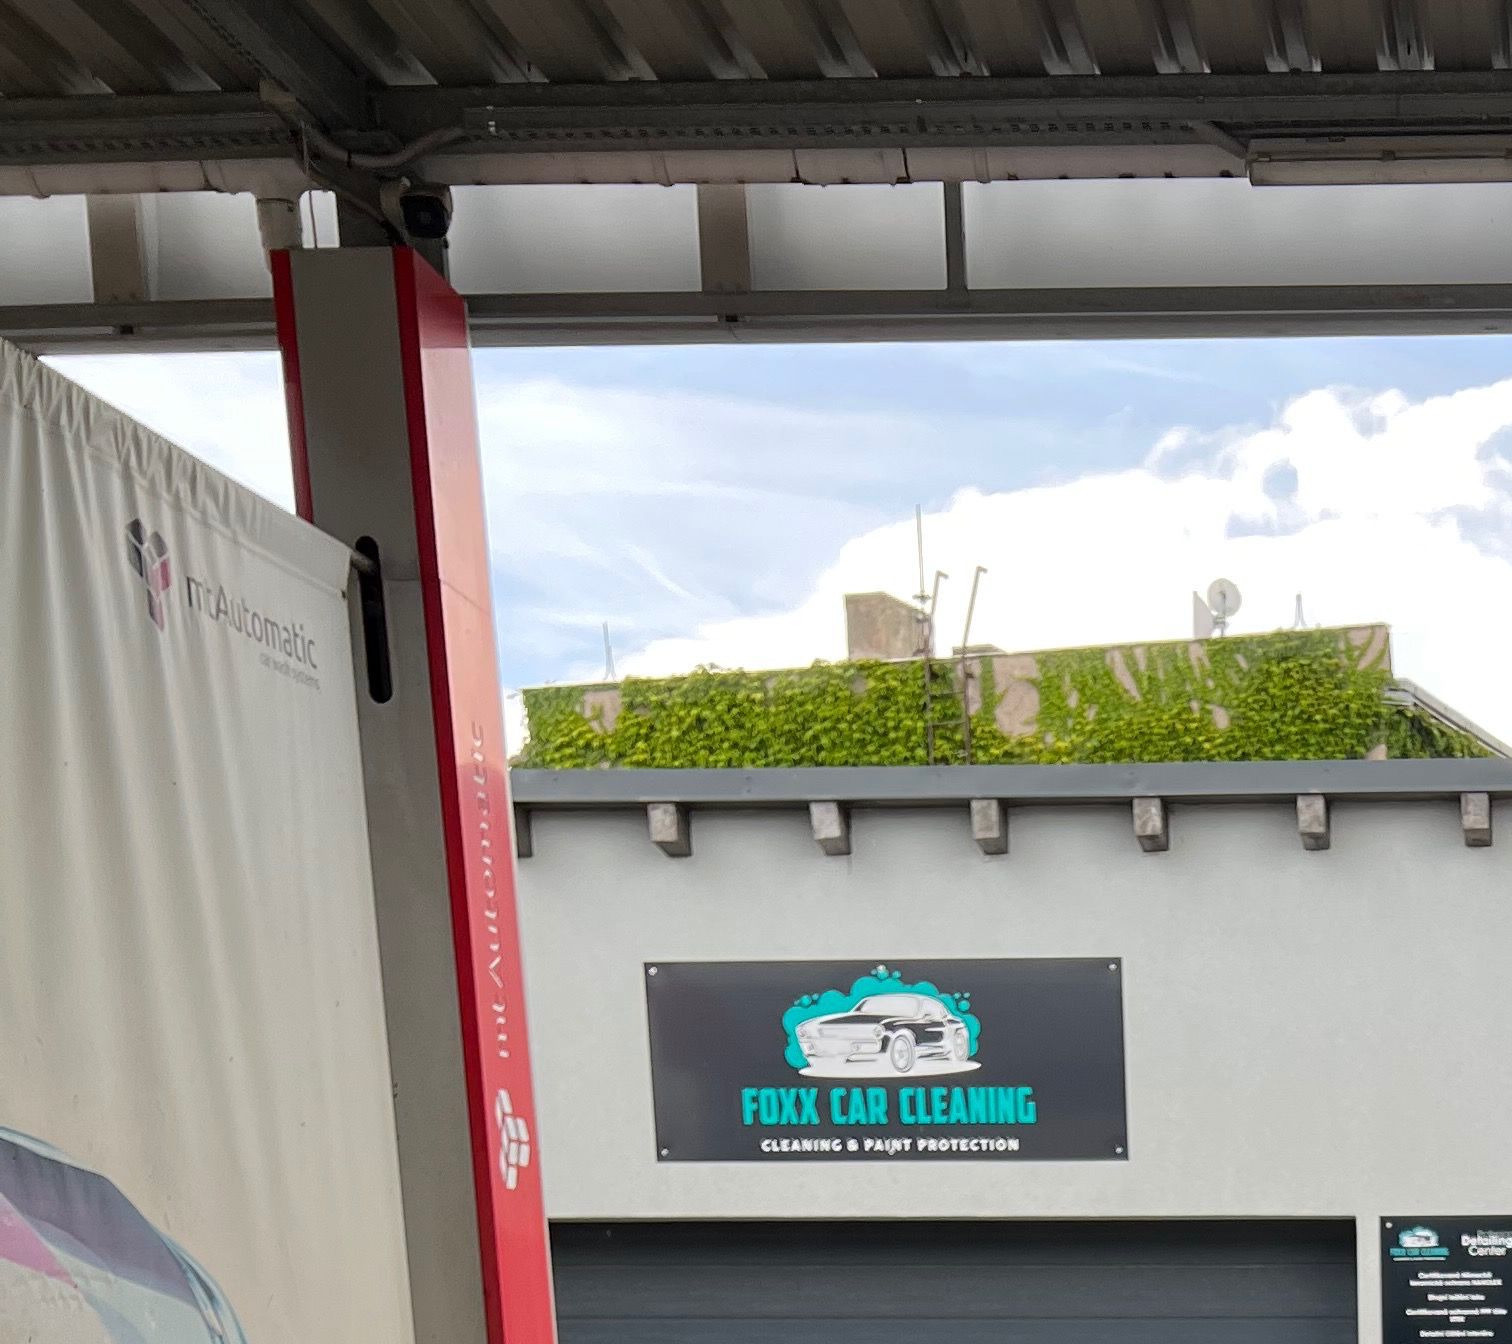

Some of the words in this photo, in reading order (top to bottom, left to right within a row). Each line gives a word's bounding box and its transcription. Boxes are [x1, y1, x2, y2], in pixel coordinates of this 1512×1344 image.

[741, 1086, 820, 1125] FOXX
[829, 1086, 888, 1125] CAR
[899, 1085, 1037, 1124] CLEANING
[760, 1137, 842, 1153] CLEANING
[846, 1138, 859, 1152] &
[863, 1137, 911, 1152] PAINT
[916, 1137, 1020, 1152] PROTECTION
[1468, 1246, 1507, 1256] Center
